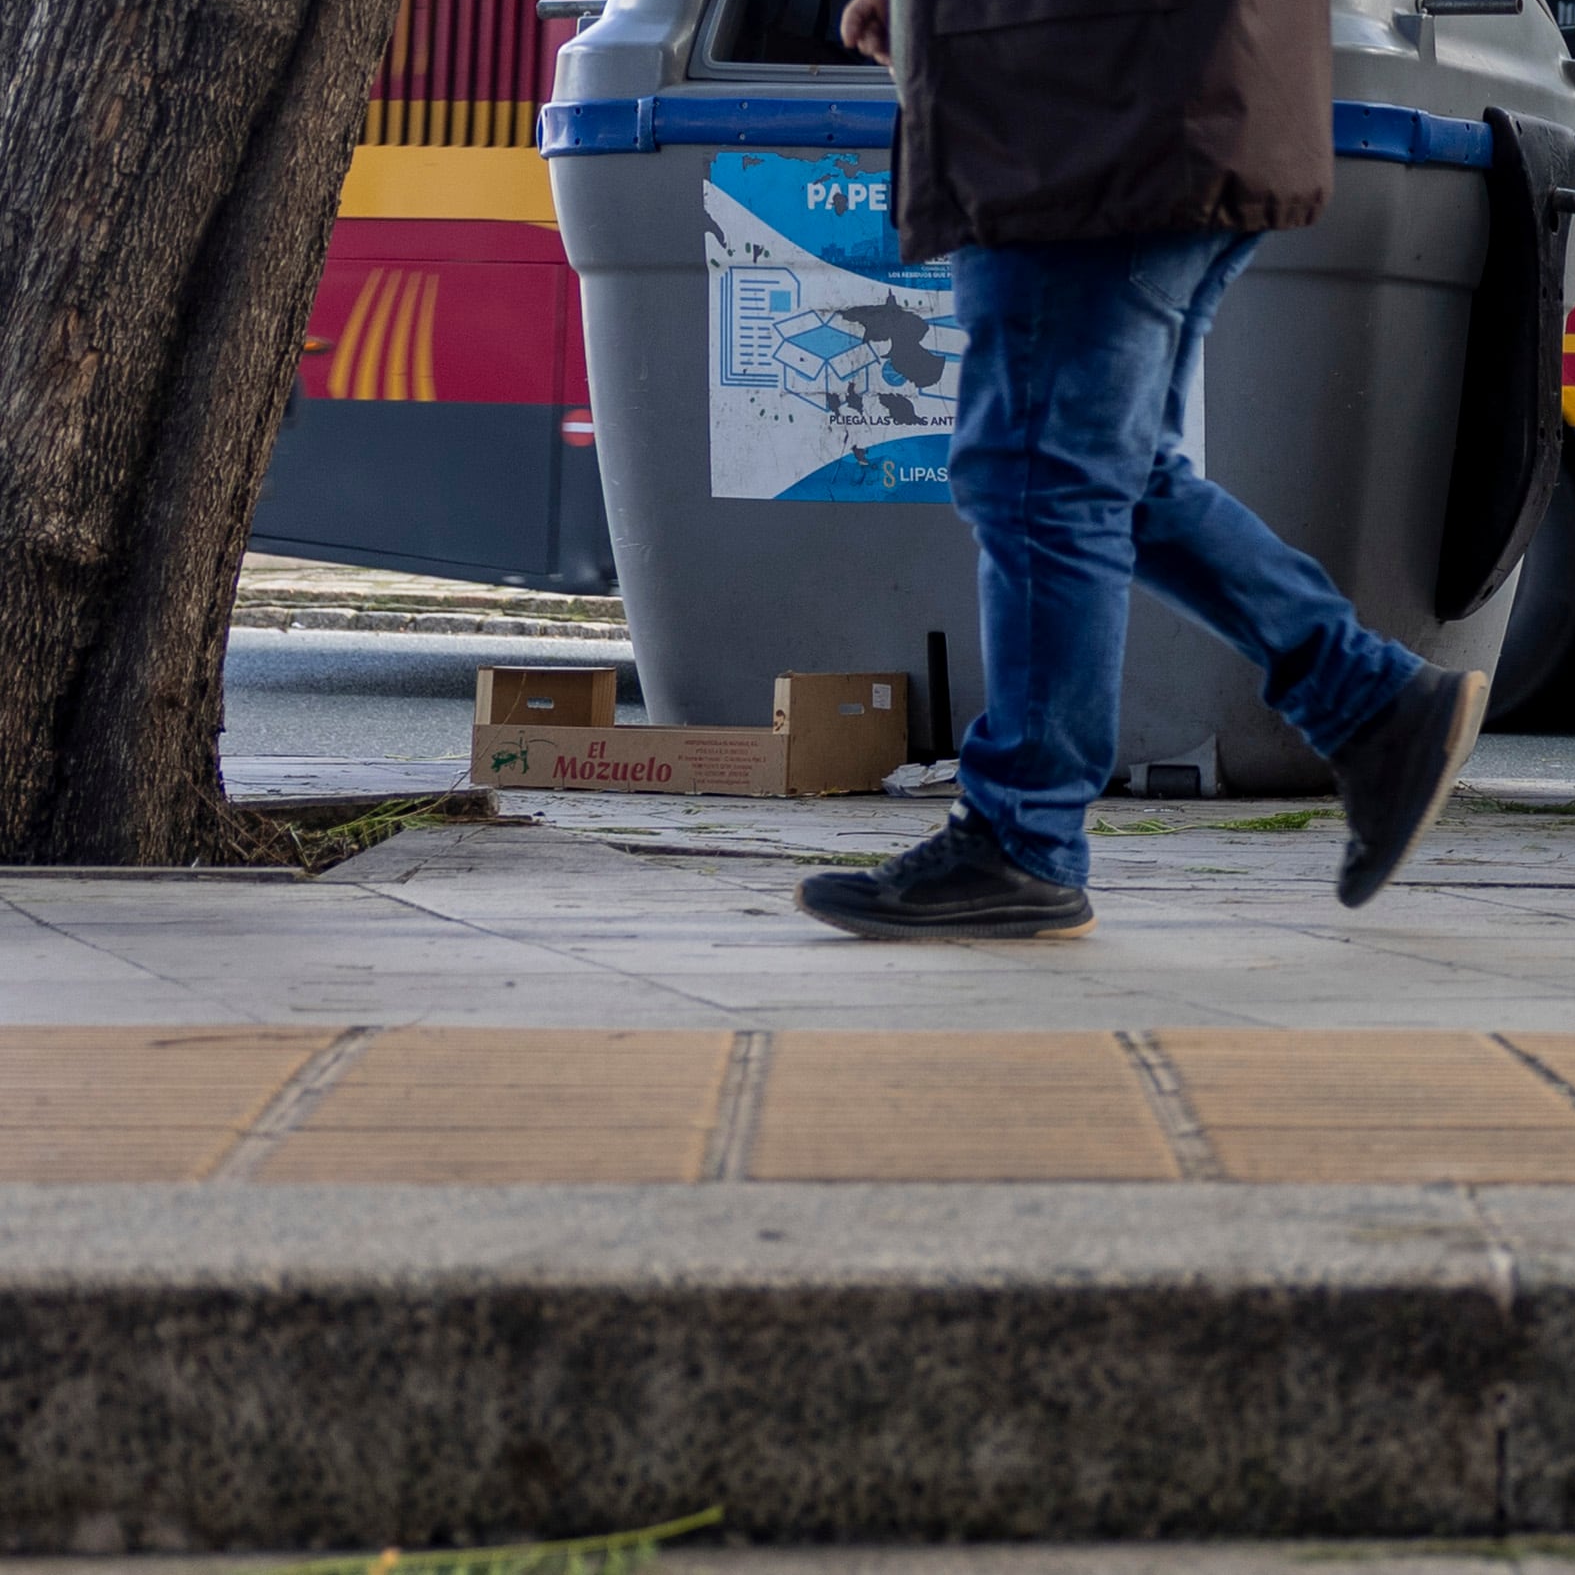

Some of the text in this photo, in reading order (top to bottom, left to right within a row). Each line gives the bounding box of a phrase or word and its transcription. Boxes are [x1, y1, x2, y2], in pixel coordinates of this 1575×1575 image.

[829, 415, 868, 425] PLIEGA
[870, 416, 891, 426] LAS
[900, 467, 949, 482] LIPAS
[588, 741, 606, 759] El
[552, 756, 672, 783] Mozuelo
